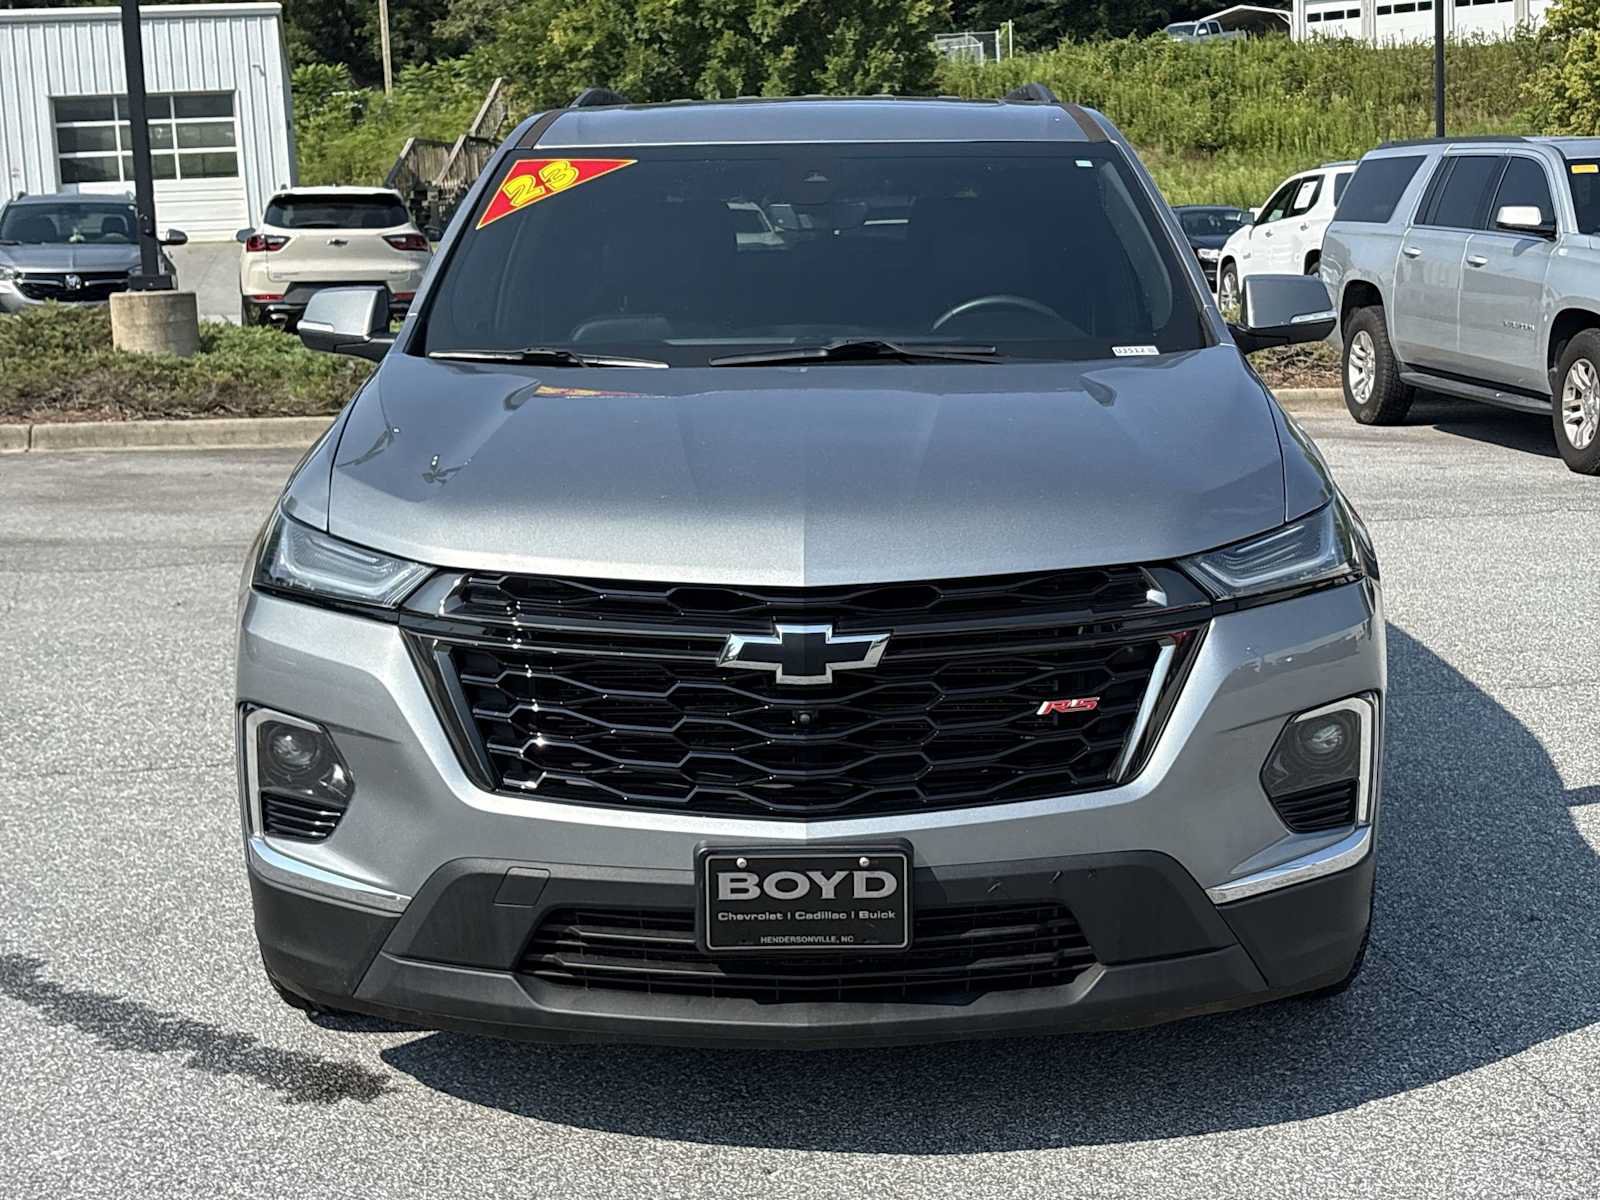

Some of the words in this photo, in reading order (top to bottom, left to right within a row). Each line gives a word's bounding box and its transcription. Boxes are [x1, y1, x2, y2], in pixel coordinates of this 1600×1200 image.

[502, 160, 580, 208] 23
[1036, 697, 1100, 715] RS
[716, 870, 898, 900] BOYD
[717, 911, 784, 921] Chevrolet
[795, 911, 848, 920] Cadillac
[858, 910, 896, 919] Buick
[760, 935, 840, 944] HENDERSONVILLE,
[841, 935, 854, 943] NC
